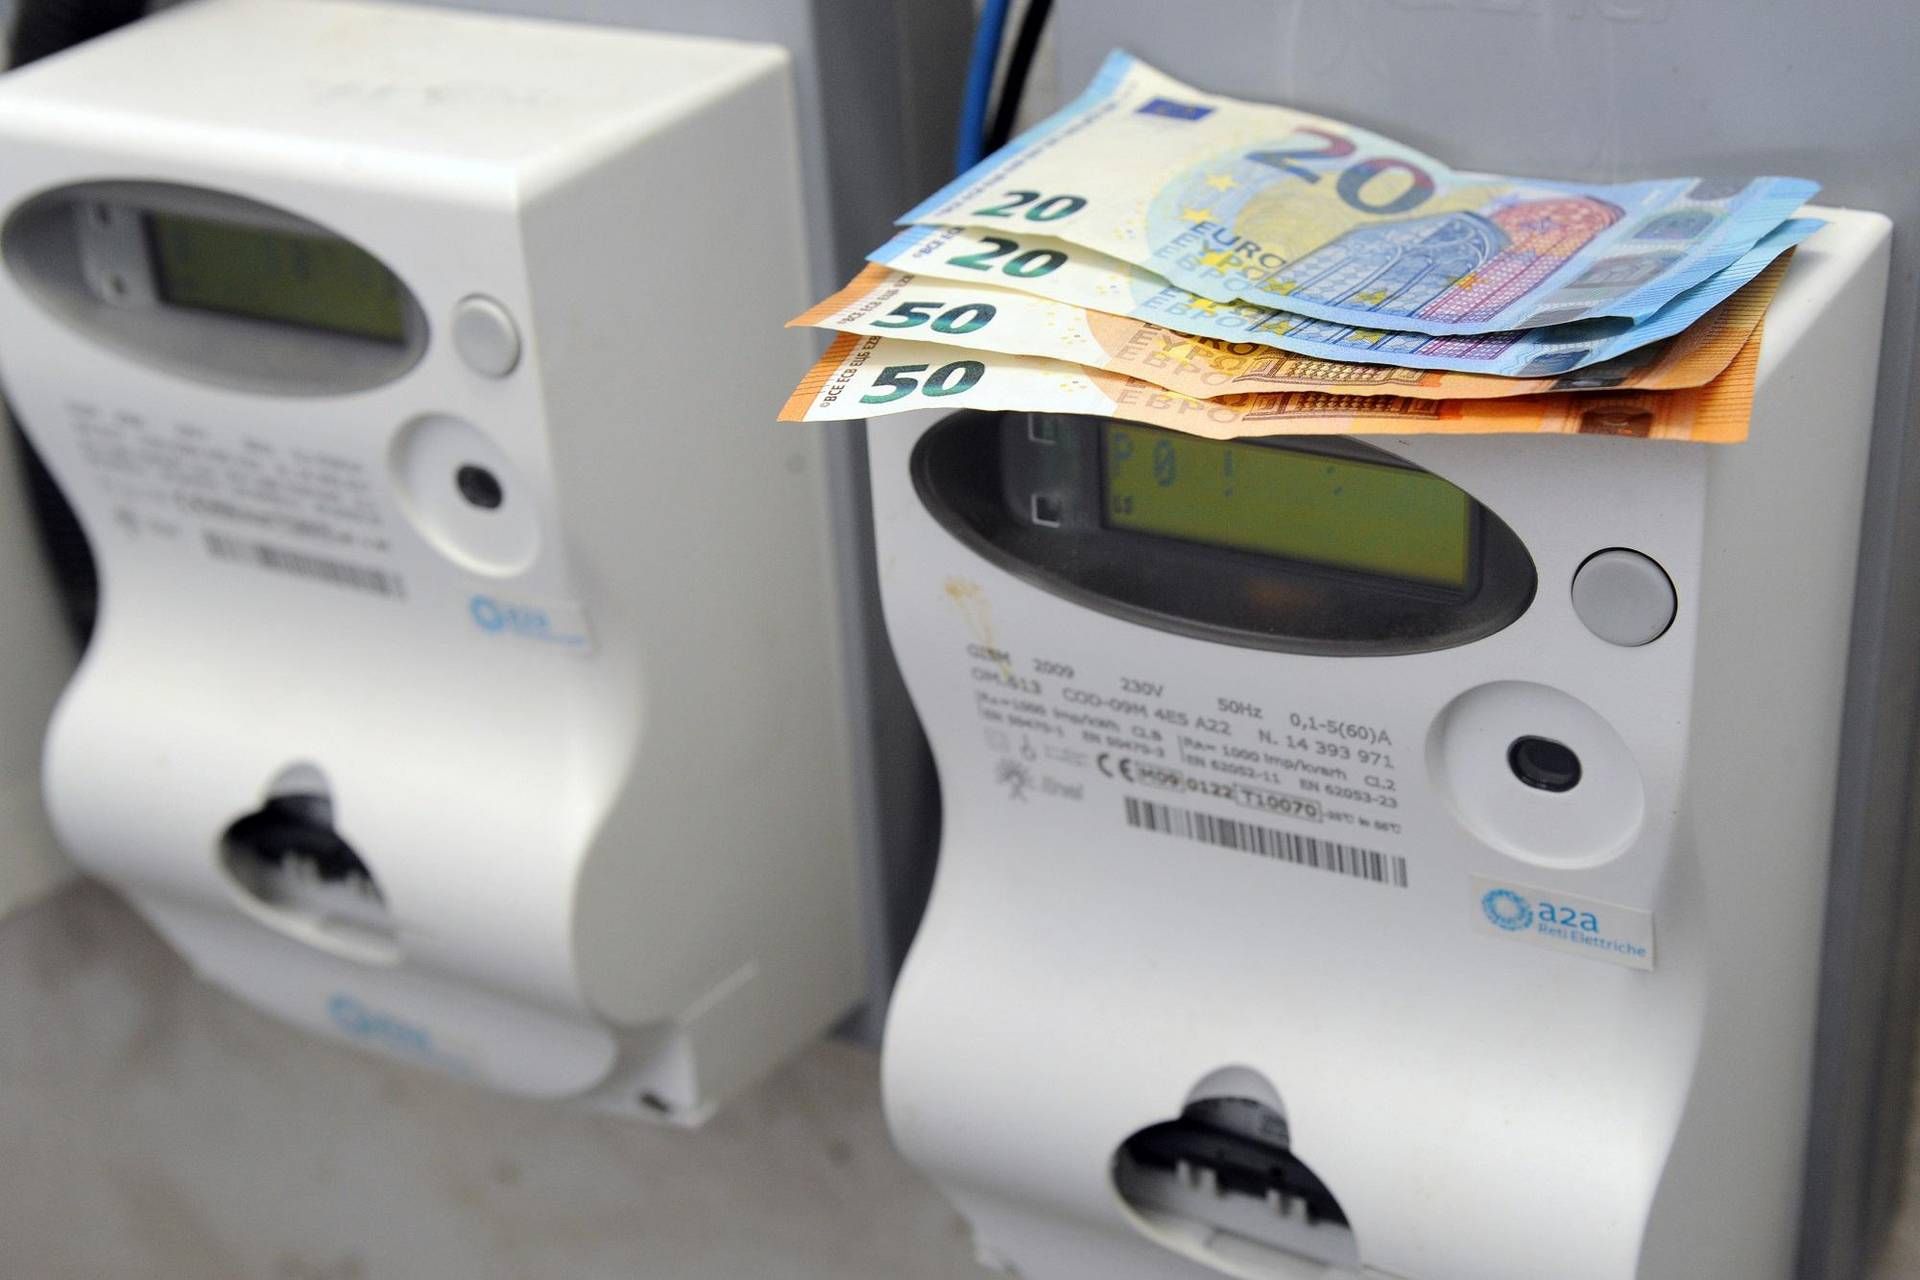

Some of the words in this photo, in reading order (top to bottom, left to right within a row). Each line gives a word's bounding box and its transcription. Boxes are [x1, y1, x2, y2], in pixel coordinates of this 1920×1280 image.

[1245, 126, 1435, 214] 20
[971, 190, 1088, 222] 20
[945, 236, 1069, 278] 20
[1189, 221, 1286, 269] EURO
[869, 302, 997, 335] 50
[858, 360, 985, 404] 50
[1033, 658, 1075, 679] 2009
[1120, 677, 1164, 698] 230V
[1217, 698, 1263, 719] 50Hz
[1289, 712, 1393, 747] 0,1-5(60)A
[1195, 716, 1232, 736] A22
[1258, 728, 1279, 745] N.
[1287, 734, 1310, 751] 14
[1315, 741, 1350, 760] 393
[1357, 749, 1395, 769] 971
[1186, 777, 1232, 799] 0122
[1243, 789, 1318, 818] T10070
[1299, 777, 1320, 793] EN
[1324, 783, 1398, 809] 62053-23
[1538, 902, 1599, 932] a2a
[1539, 922, 1569, 940] Reti
[1570, 931, 1648, 957] Elettriche
